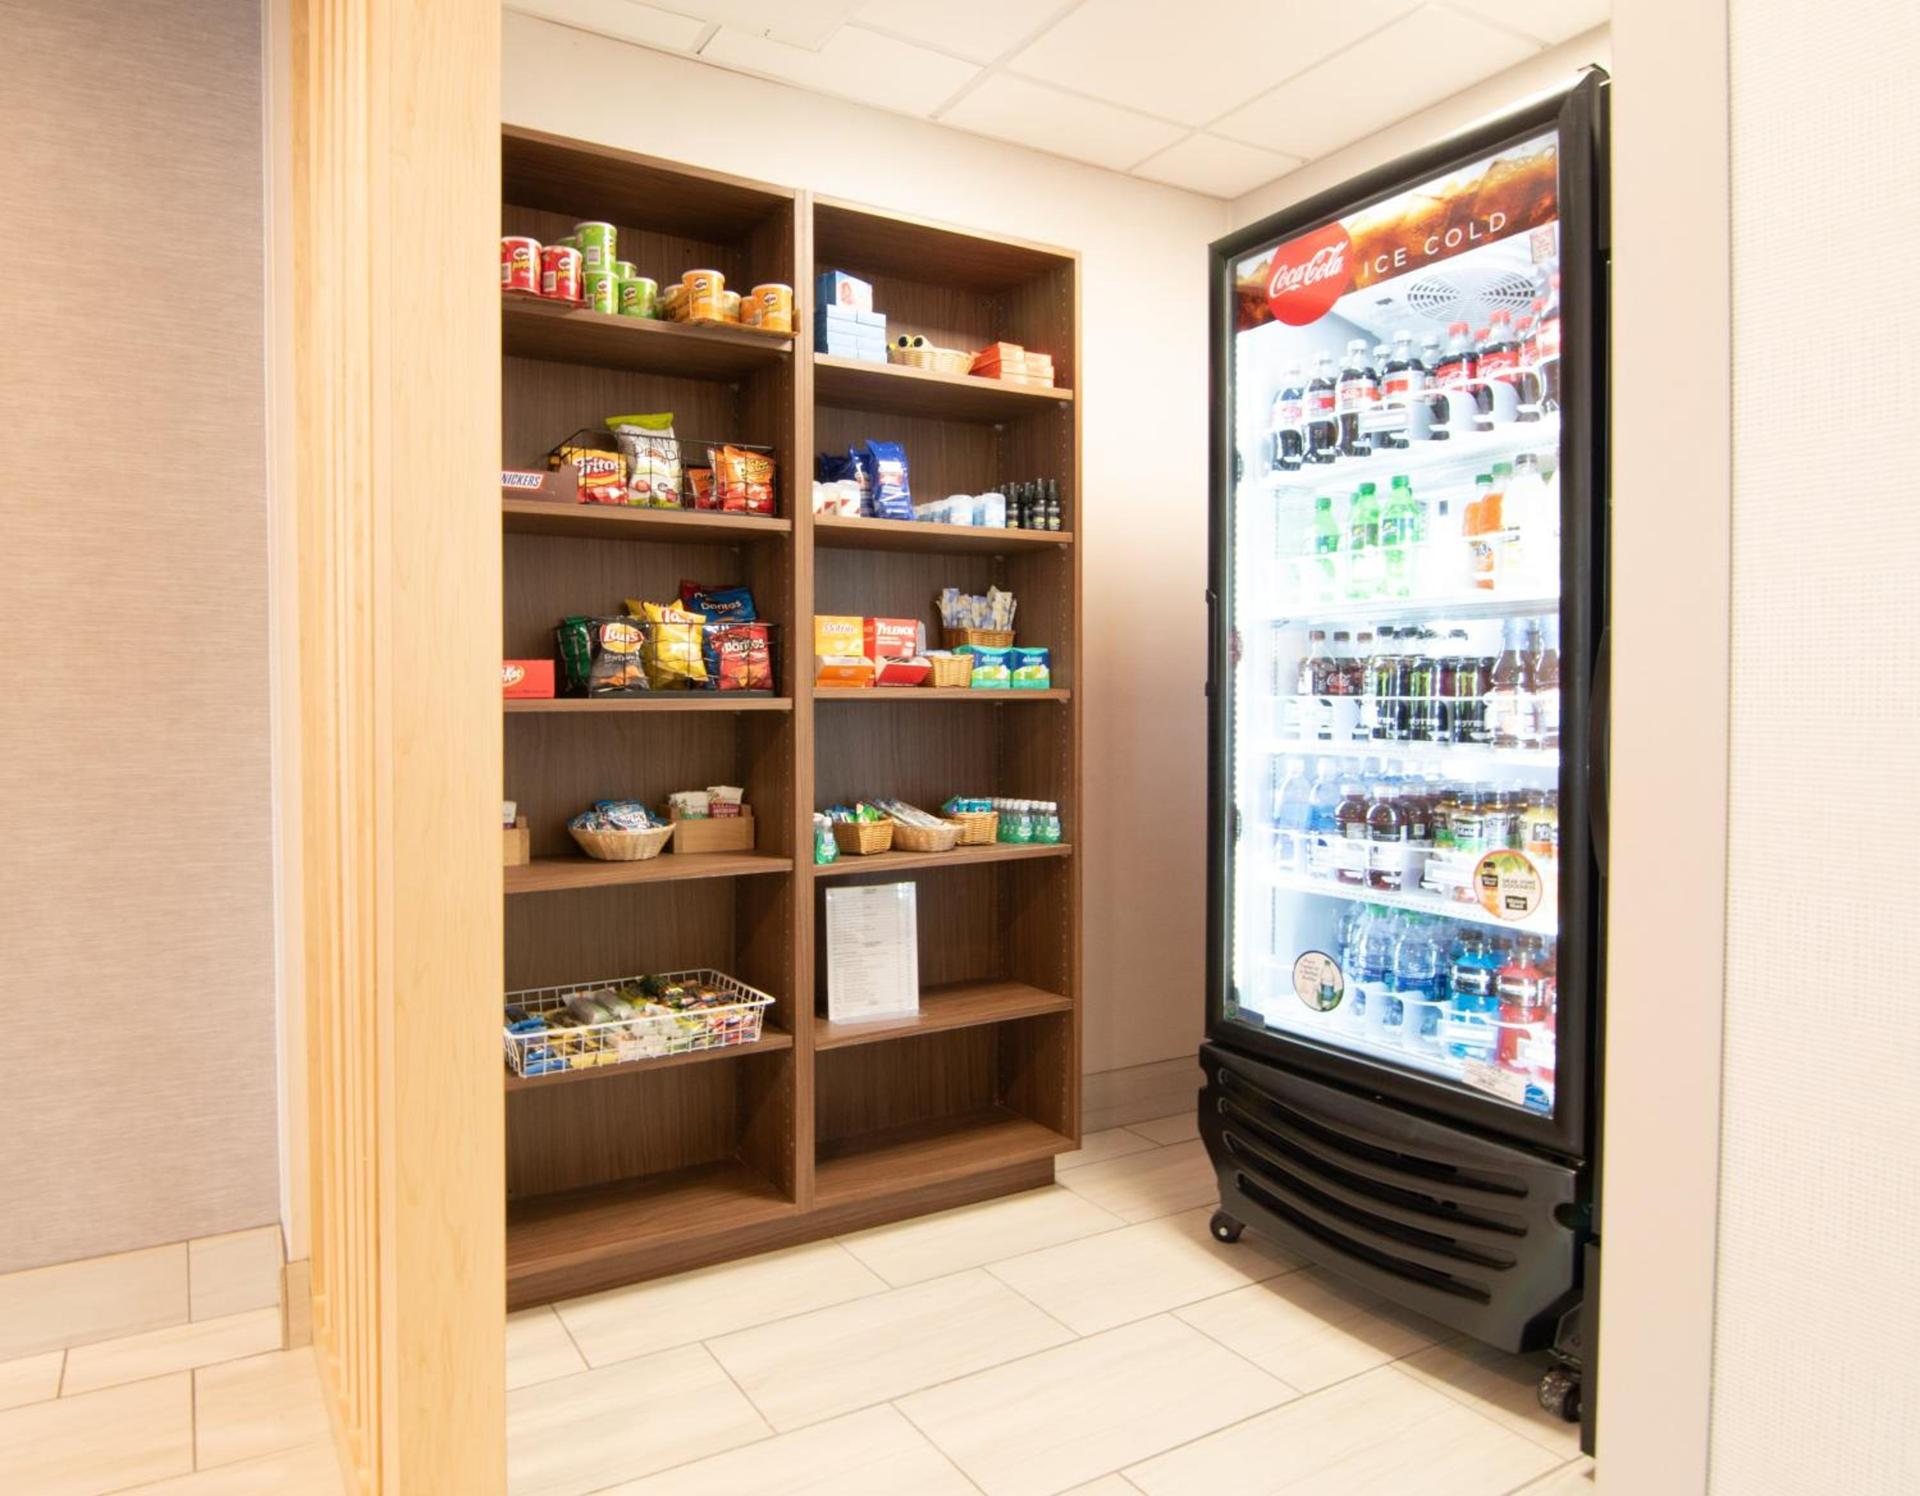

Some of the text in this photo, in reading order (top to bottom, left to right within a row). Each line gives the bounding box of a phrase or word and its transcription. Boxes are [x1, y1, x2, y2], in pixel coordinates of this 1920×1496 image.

[1362, 247, 1408, 278] ICE
[1423, 211, 1507, 255] COLD
[502, 473, 542, 488] NICKERS
